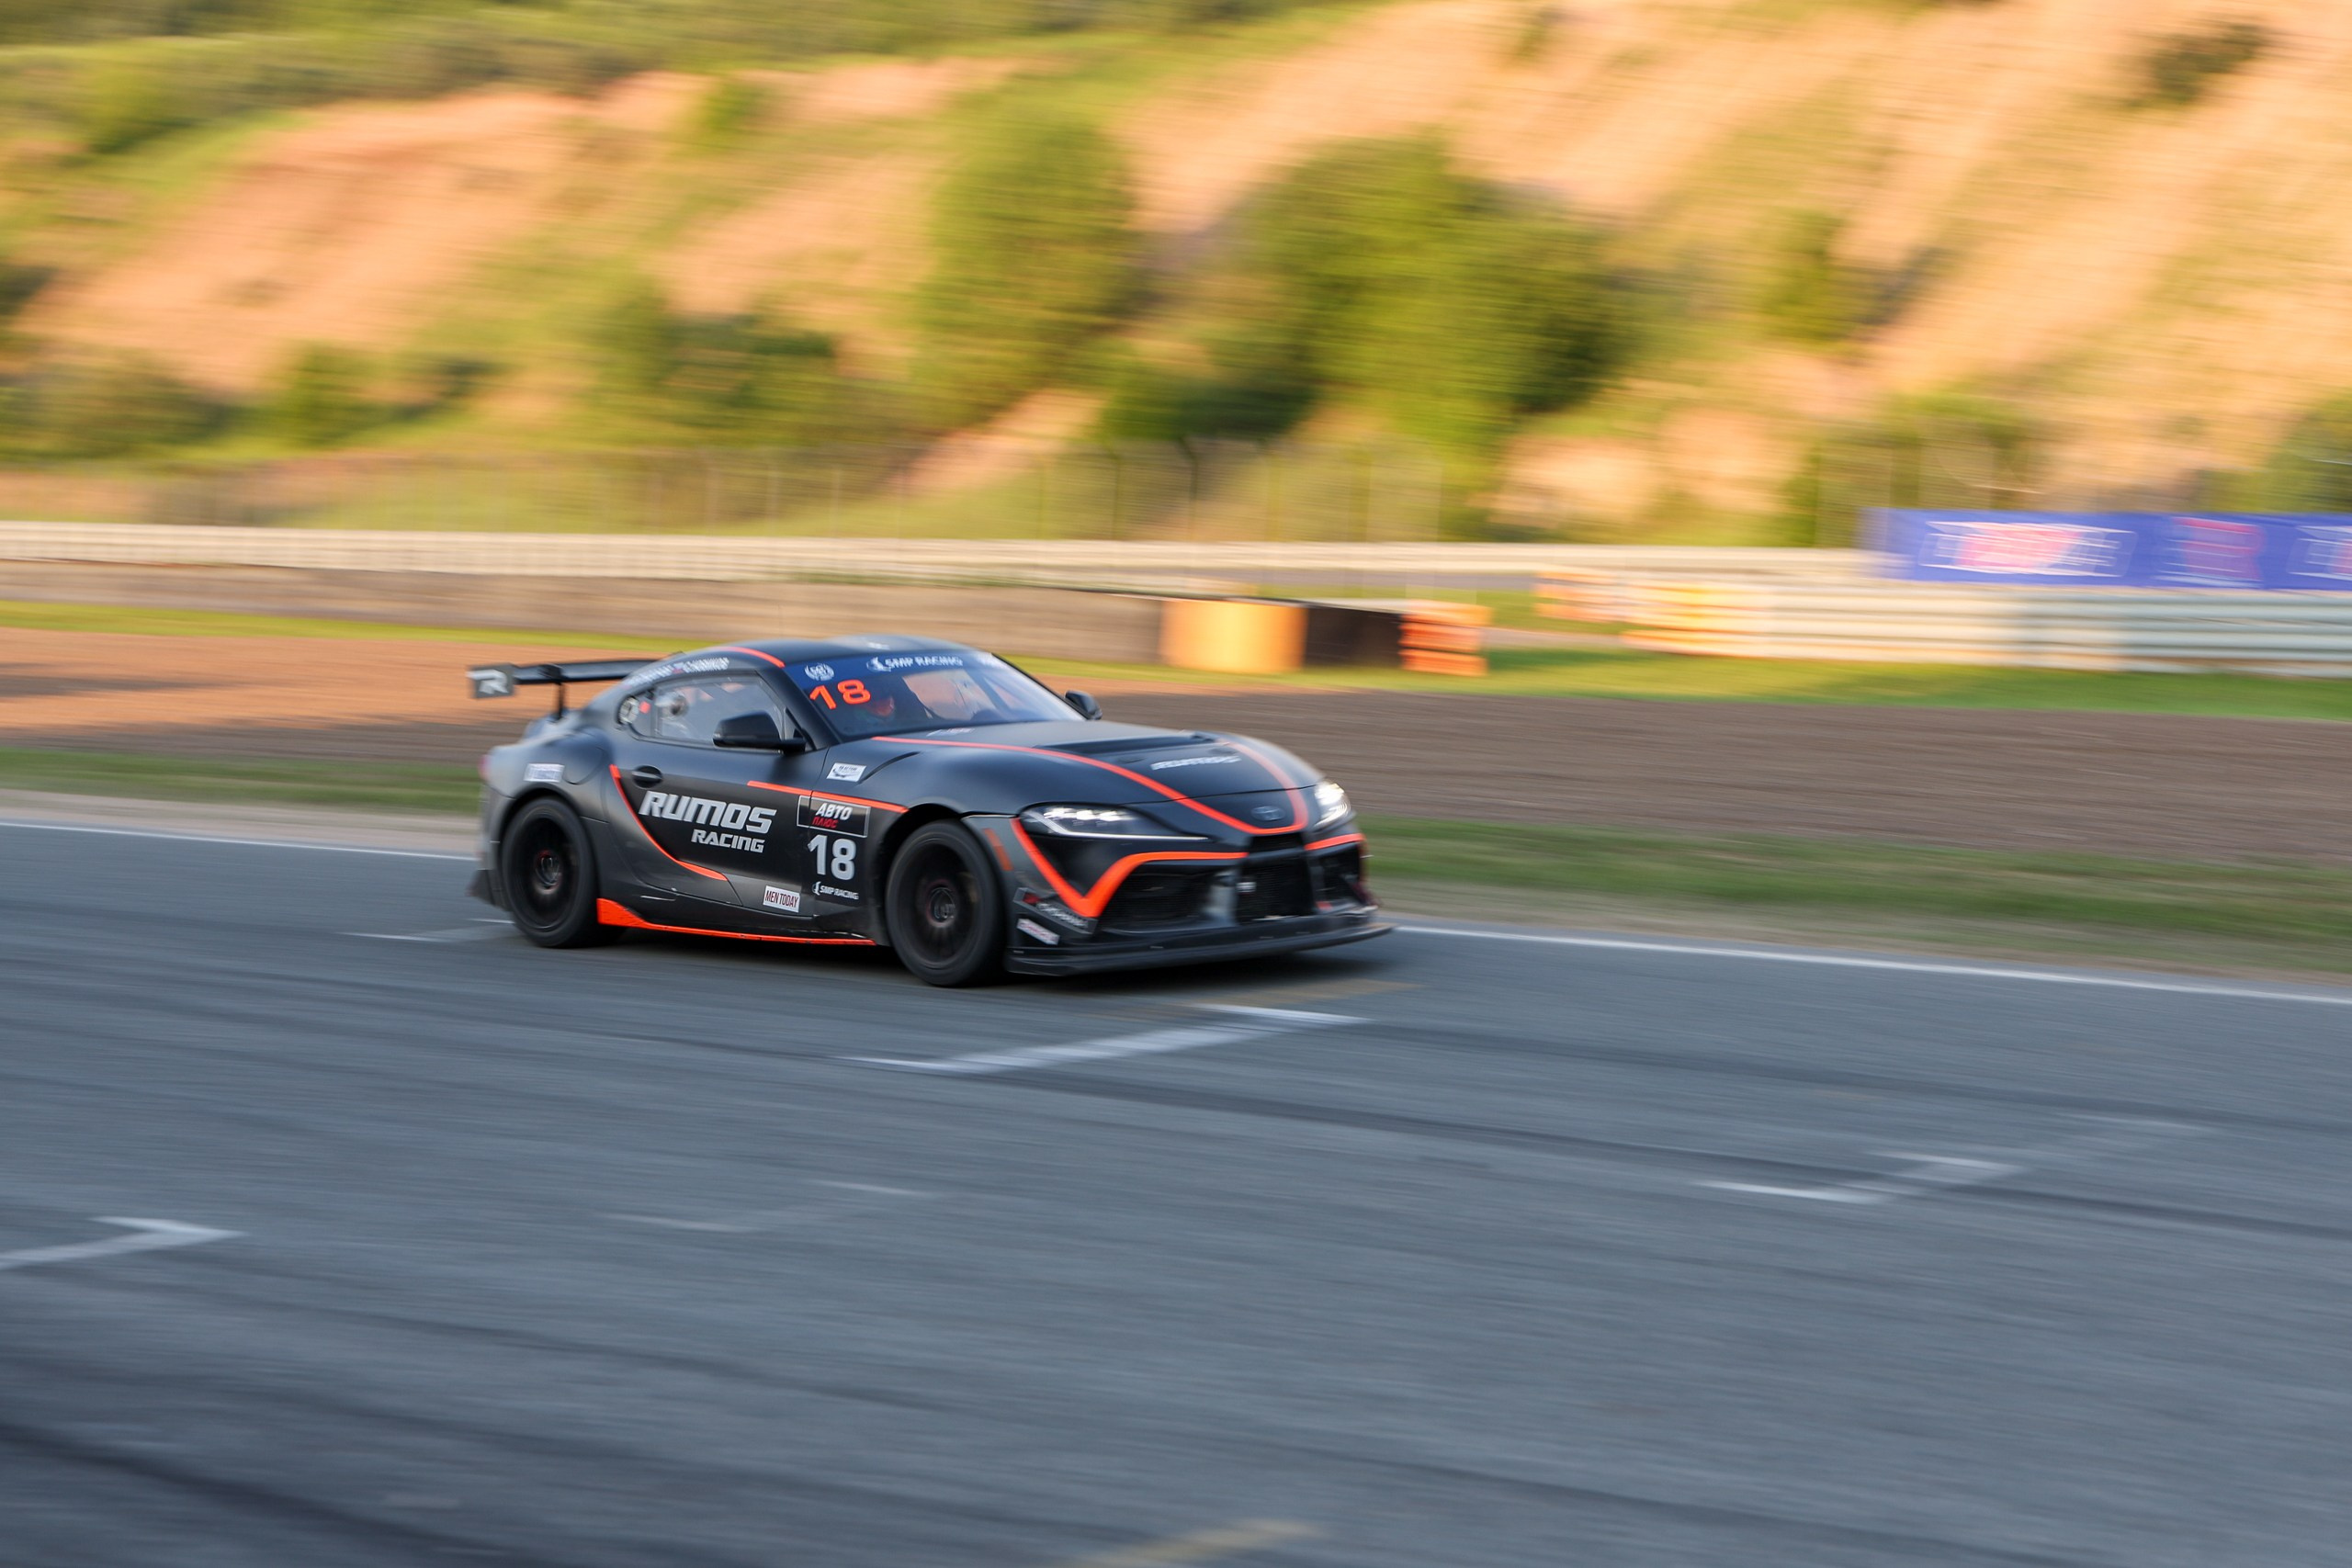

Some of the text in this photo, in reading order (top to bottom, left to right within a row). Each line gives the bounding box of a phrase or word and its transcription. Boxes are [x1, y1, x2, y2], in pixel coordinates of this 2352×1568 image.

[885, 657, 914, 669] SMP
[808, 679, 871, 710] 18
[639, 790, 777, 834] RUMOS
[815, 803, 854, 820] АВТО
[691, 829, 765, 853] RACING
[808, 834, 857, 880] 18
[764, 889, 799, 908] MEN TODAY
[820, 885, 834, 895] SMP
